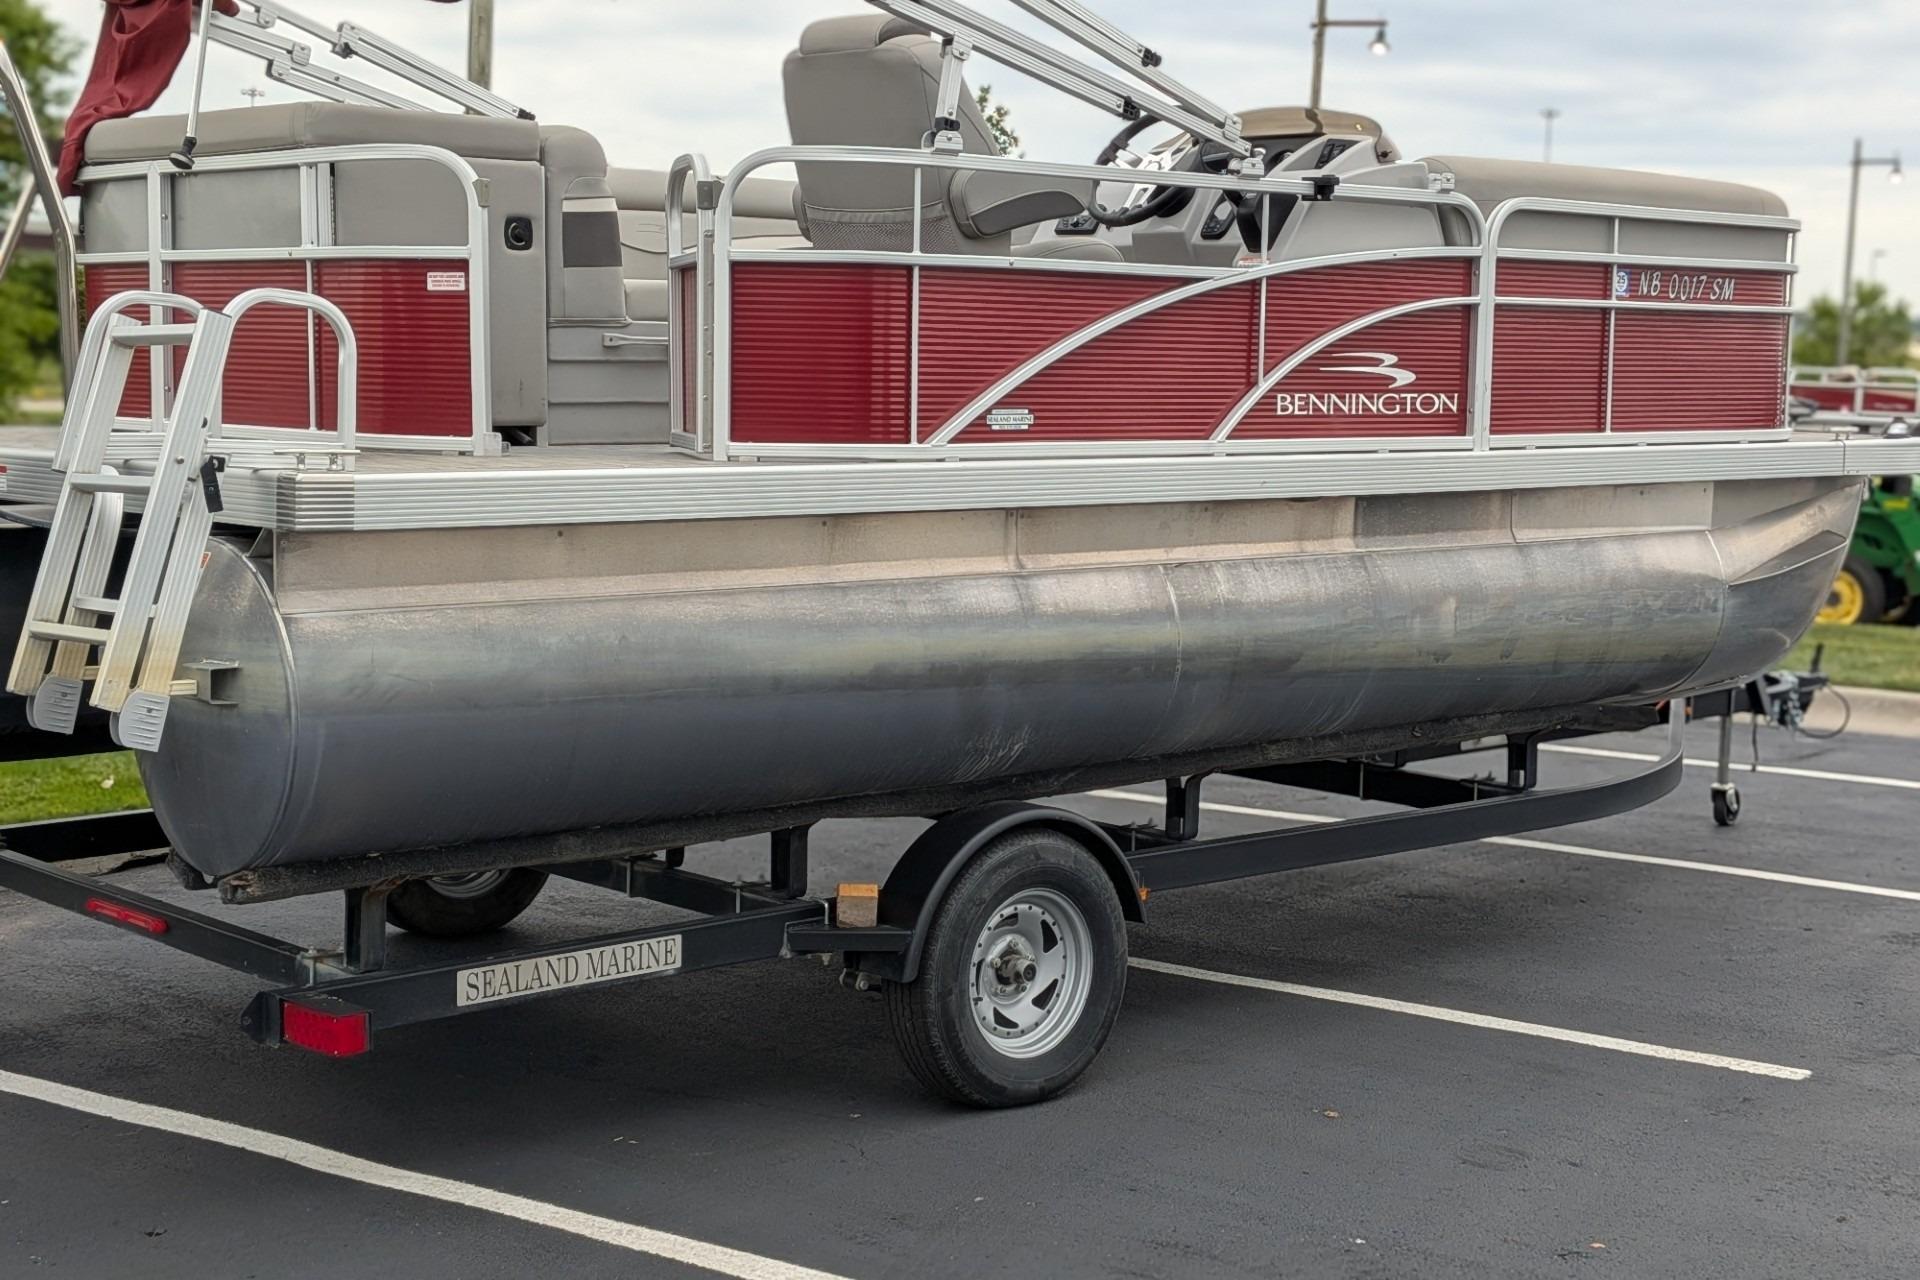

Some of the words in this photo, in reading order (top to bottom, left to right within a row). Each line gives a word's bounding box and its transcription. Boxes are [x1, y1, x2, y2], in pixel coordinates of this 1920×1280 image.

[1638, 270, 1661, 296] NB
[1668, 273, 1708, 301] 0017
[1710, 278, 1735, 301] SM
[1276, 393, 1458, 415] BENNINGTON
[465, 955, 579, 1003] SEALAND
[585, 937, 677, 980] MARINE
